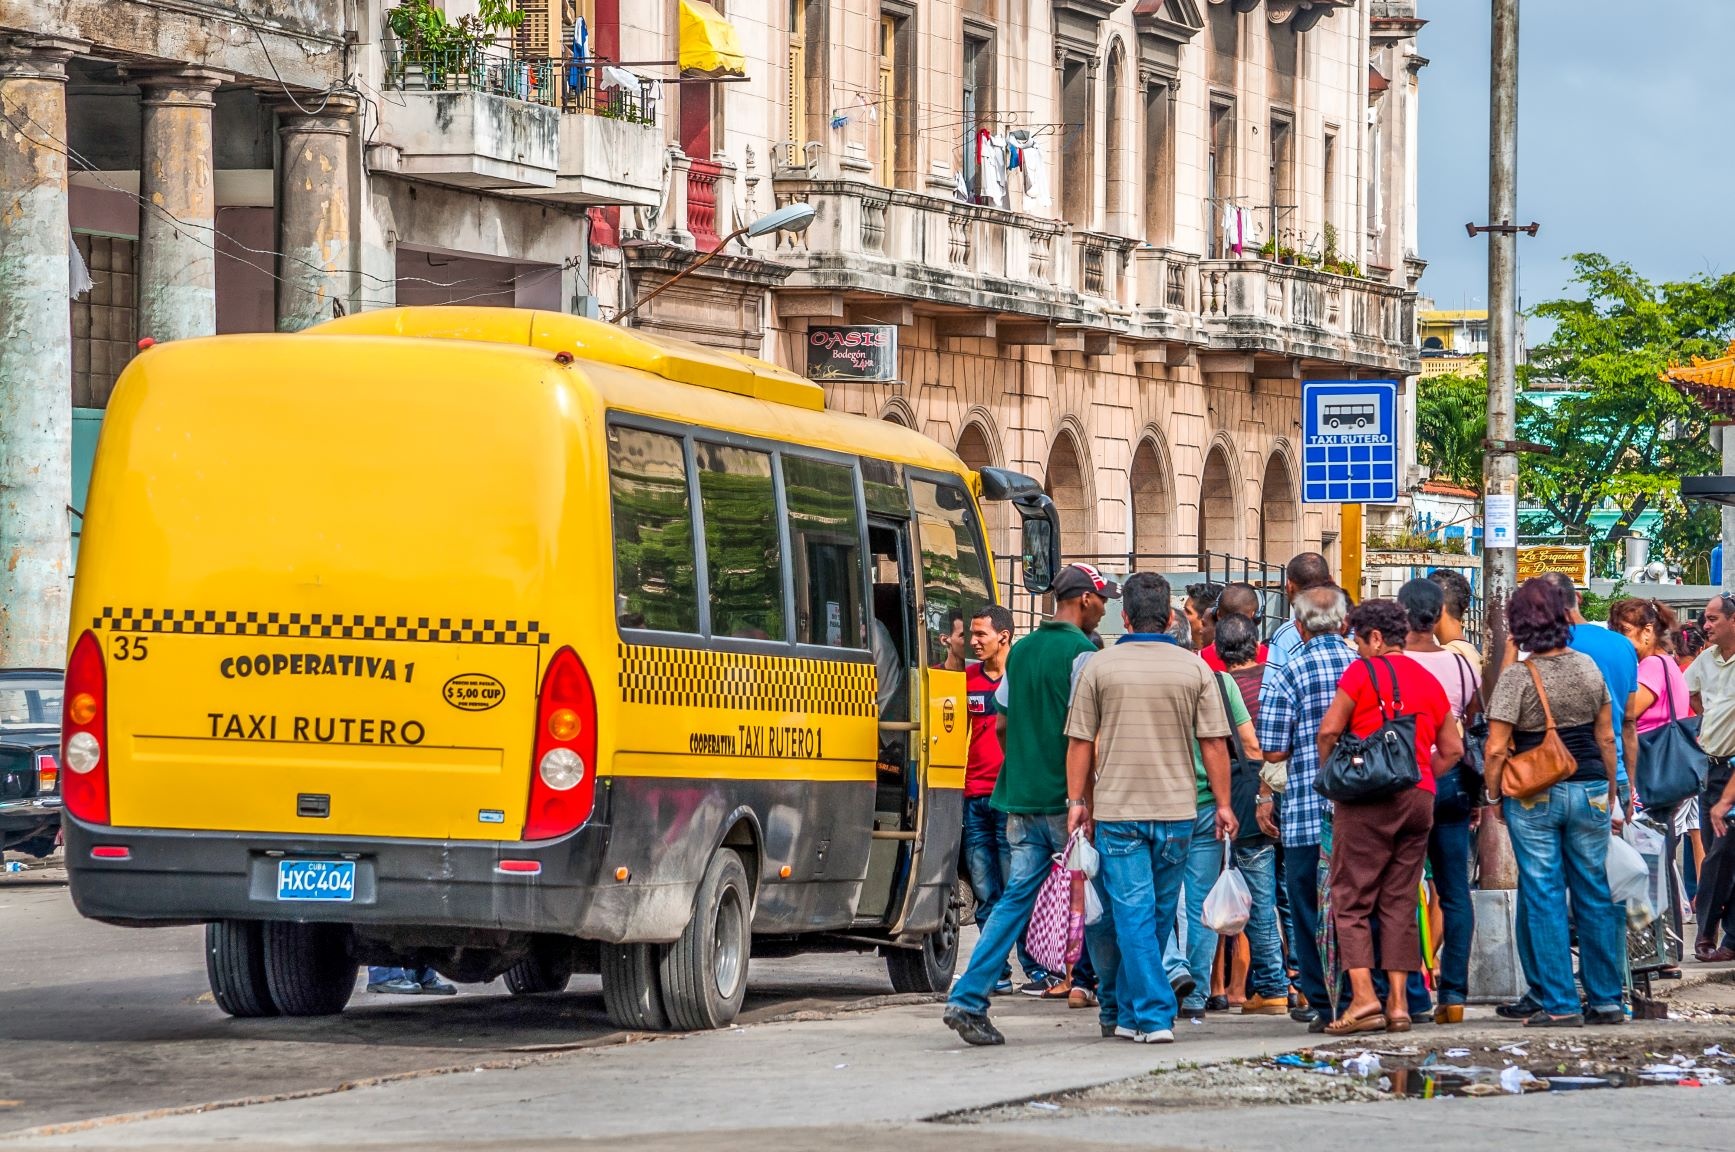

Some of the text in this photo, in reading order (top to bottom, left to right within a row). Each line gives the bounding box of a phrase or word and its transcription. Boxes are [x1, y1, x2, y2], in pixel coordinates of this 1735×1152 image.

[810, 331, 889, 349] OASIS
[832, 349, 866, 362] Bodegón
[1310, 434, 1388, 444] TAXI RUTERO
[1519, 550, 1578, 564] La Esquina
[113, 635, 149, 661] 35
[220, 654, 415, 683] COOPERATIVA 1
[447, 686, 501, 700] $ 5,00 CUP
[207, 713, 426, 745] TAXI RUTERO
[690, 725, 822, 758] COOPERATIVA TAXI RUTERO 1
[308, 863, 326, 871] CUBA
[280, 870, 352, 891] HXC404
